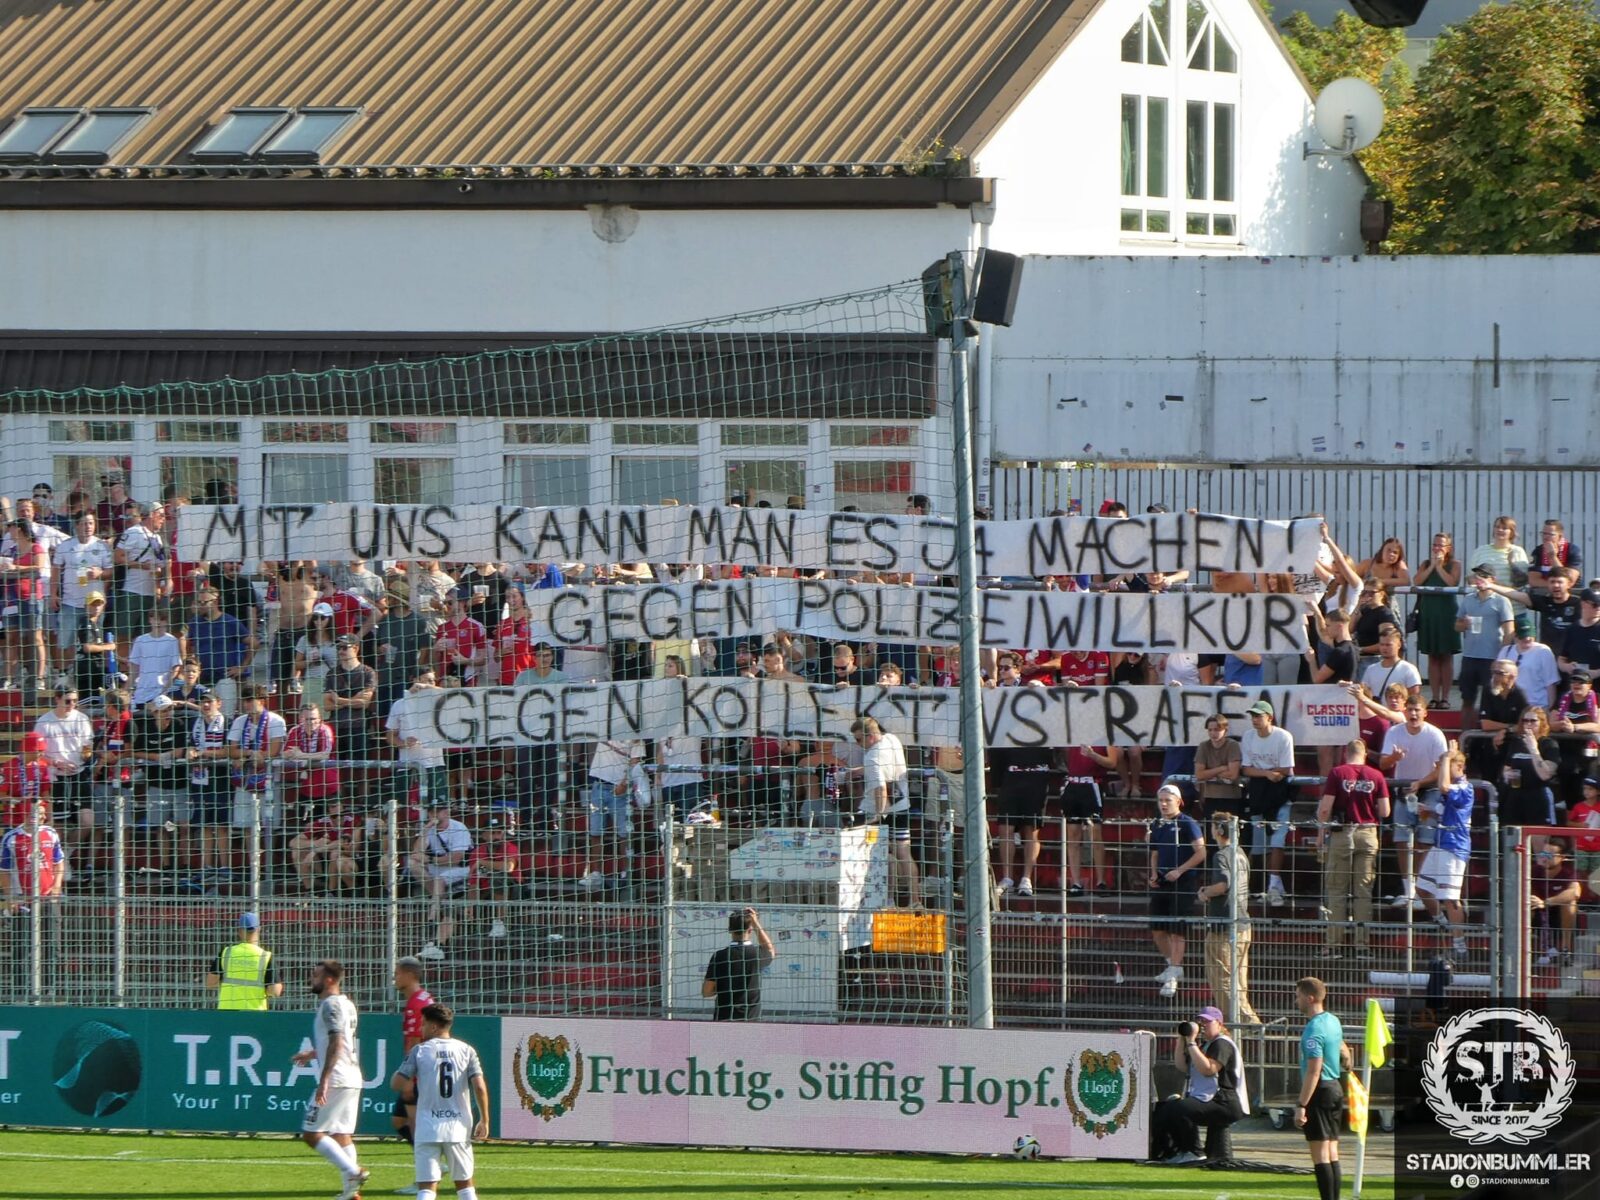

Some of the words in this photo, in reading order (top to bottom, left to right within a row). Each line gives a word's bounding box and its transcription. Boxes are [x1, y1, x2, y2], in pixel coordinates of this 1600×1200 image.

[201, 504, 313, 562] MIT
[350, 504, 459, 560] UNS
[496, 504, 647, 562] KANN
[688, 507, 796, 565] MAN
[827, 514, 899, 571] ES
[548, 580, 753, 646] GEGEN
[433, 683, 642, 745] GEGEN
[1307, 704, 1355, 715] CLASSIC
[1314, 716, 1350, 727] SQUAD
[173, 1093, 218, 1110] Your
[235, 1094, 251, 1110] IT
[440, 1061, 453, 1098] 6
[586, 1056, 784, 1110] Fruchtig.
[799, 1060, 924, 1115] Süffig
[938, 1065, 1061, 1118] Hopf.
